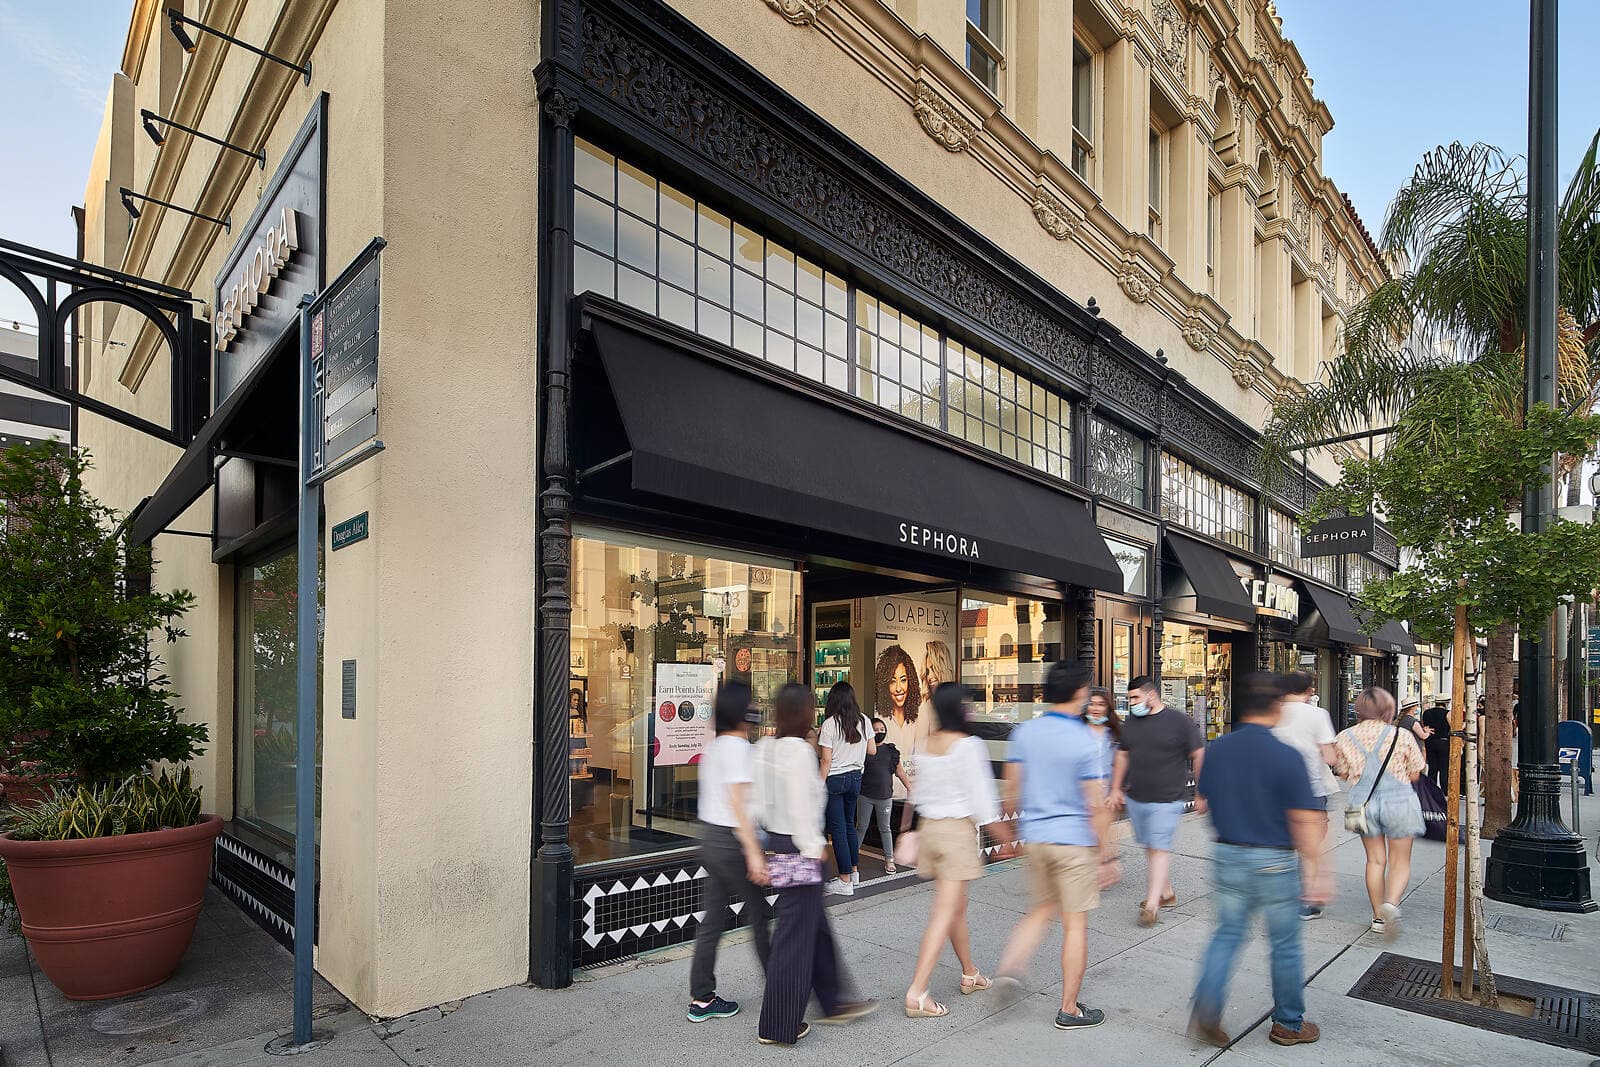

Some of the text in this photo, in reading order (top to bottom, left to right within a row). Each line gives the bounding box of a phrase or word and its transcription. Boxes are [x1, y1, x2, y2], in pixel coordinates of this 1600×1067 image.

[215, 207, 299, 352] SEPHORA
[899, 522, 979, 559] SEPHORA
[1306, 529, 1368, 544] SEPHORA
[883, 602, 949, 628] OLAPLEX
[675, 685, 695, 694] Points
